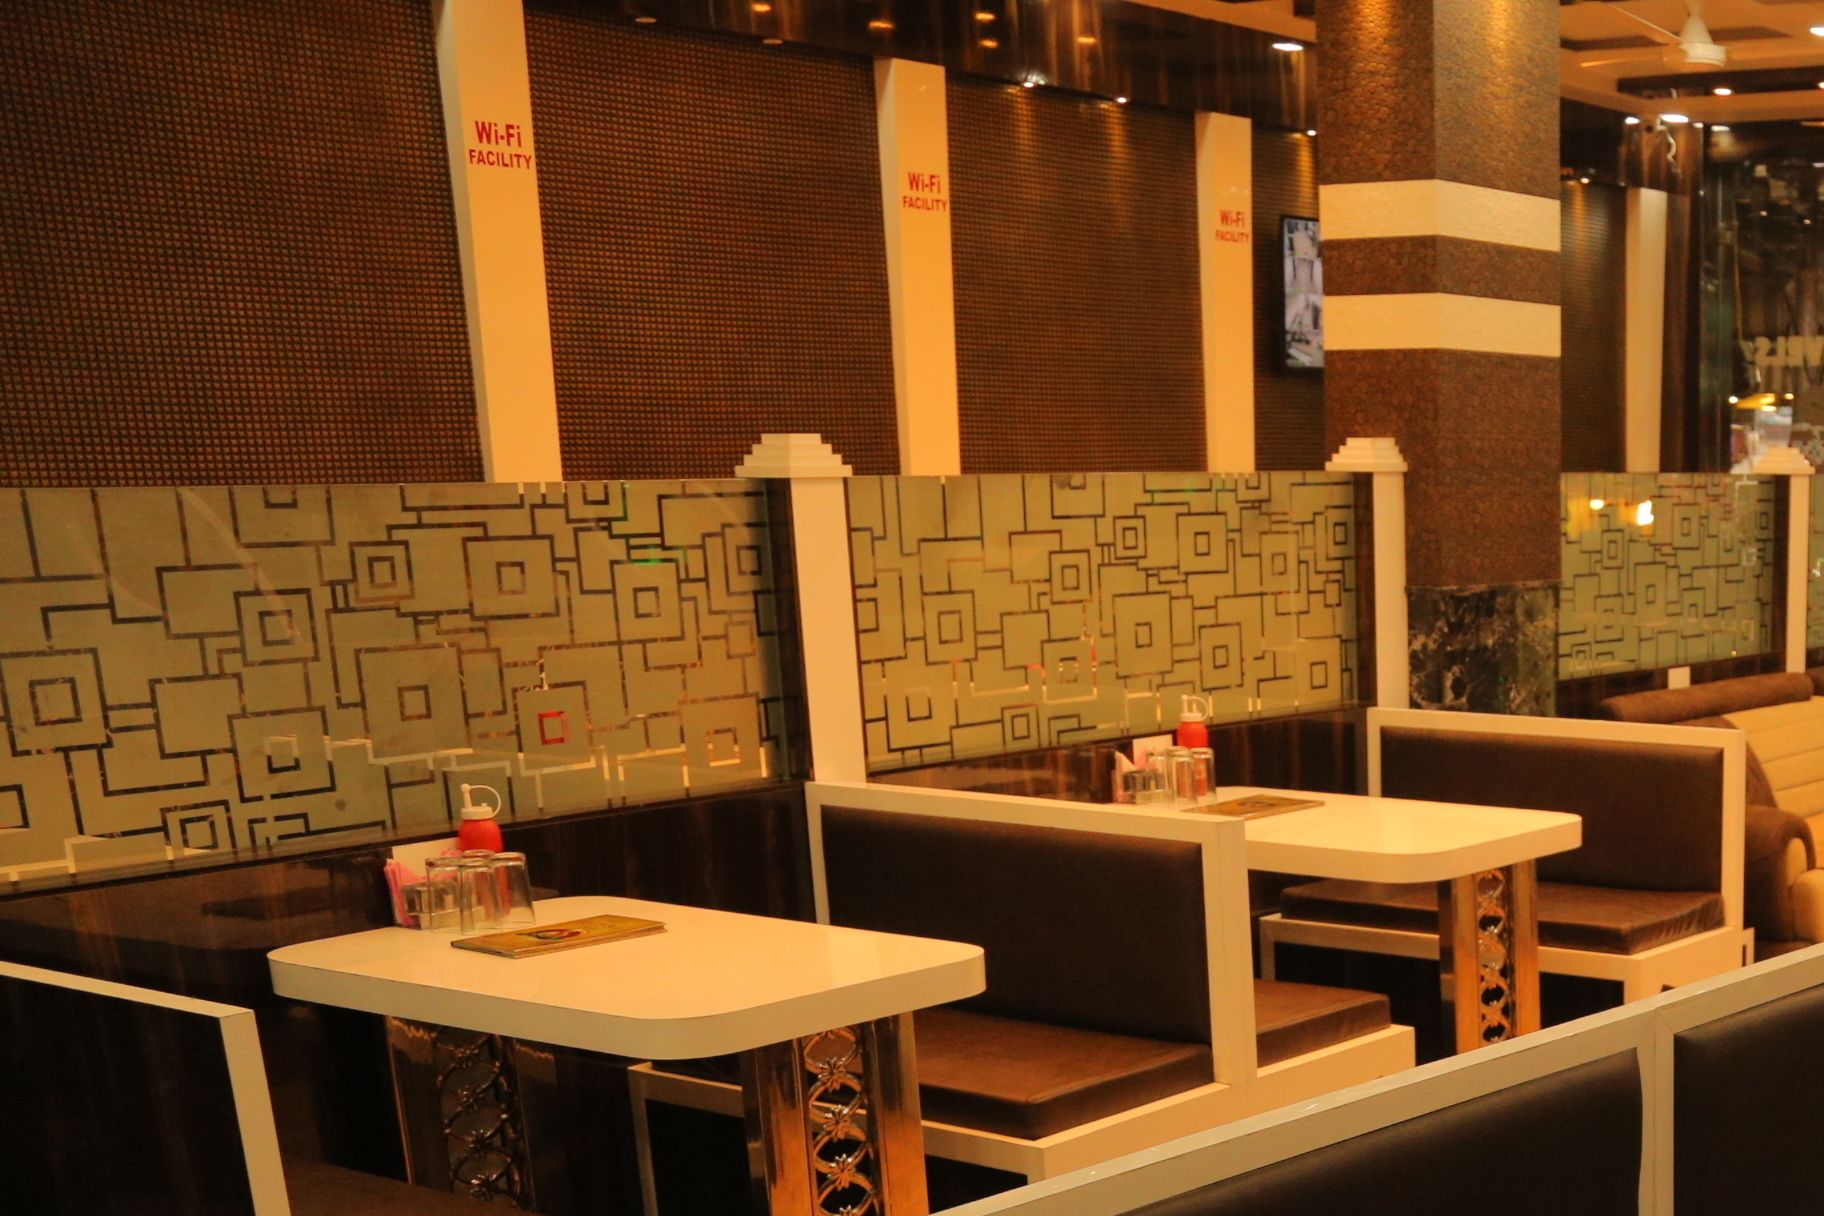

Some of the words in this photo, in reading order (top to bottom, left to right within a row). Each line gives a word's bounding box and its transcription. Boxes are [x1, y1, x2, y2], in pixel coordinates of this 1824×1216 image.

[475, 120, 522, 148] Wi-Fi
[469, 149, 532, 170] FACILITY
[908, 171, 941, 193] Wi-Fi
[903, 195, 947, 212] FACILITY
